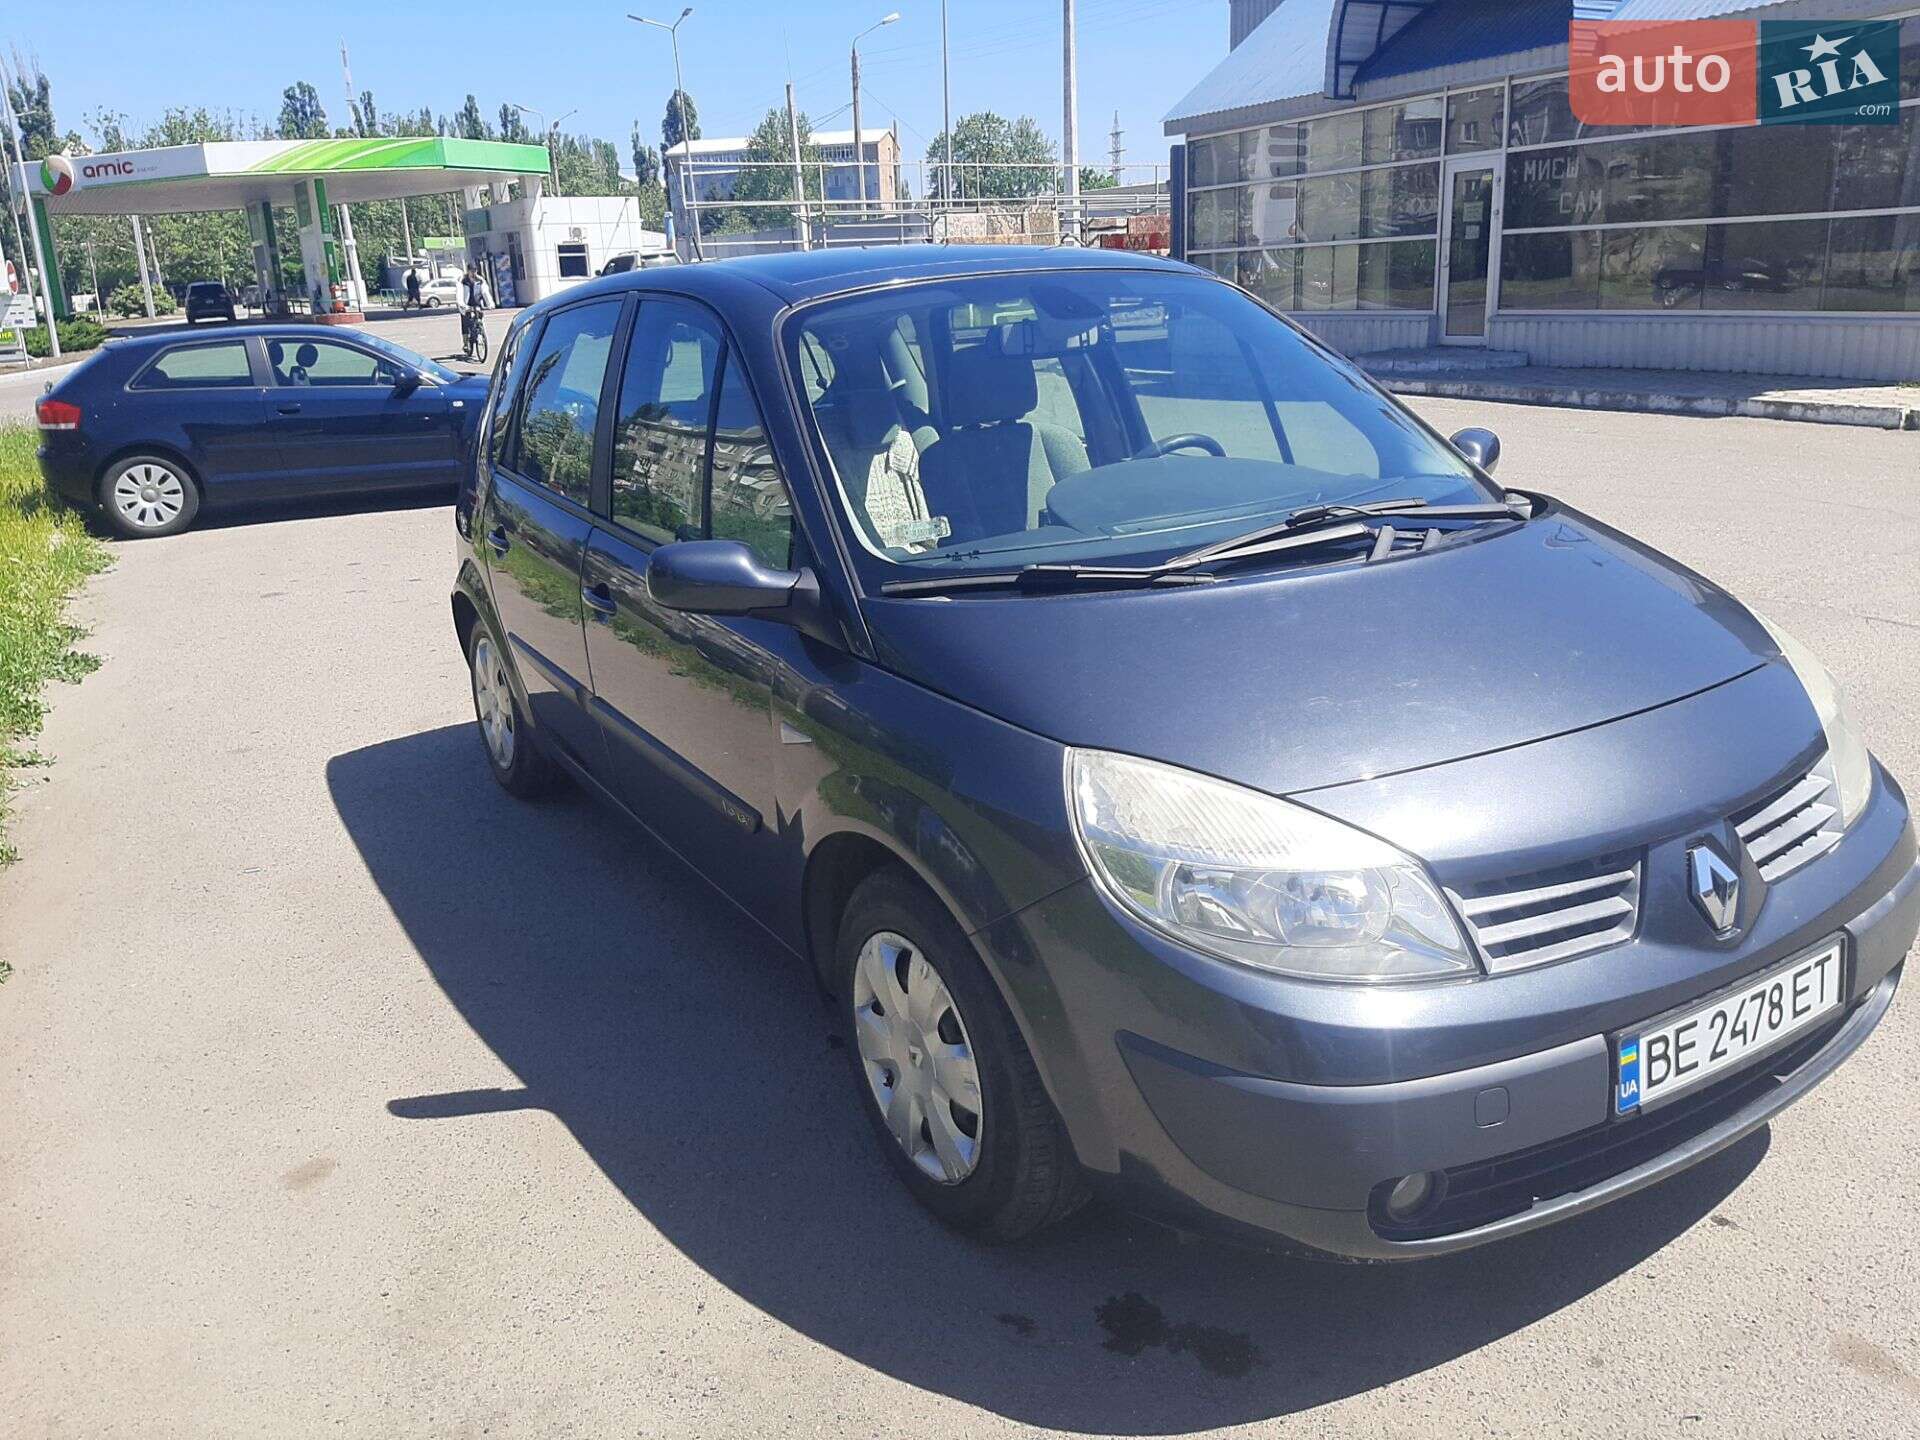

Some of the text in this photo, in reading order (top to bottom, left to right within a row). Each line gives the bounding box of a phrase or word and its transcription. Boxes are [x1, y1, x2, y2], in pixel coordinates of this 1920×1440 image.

[82, 158, 134, 178] amic
[1559, 188, 1602, 214] САМ
[1646, 953, 1833, 1089] BE 2478 ET
[1620, 1079, 1638, 1099] UA
